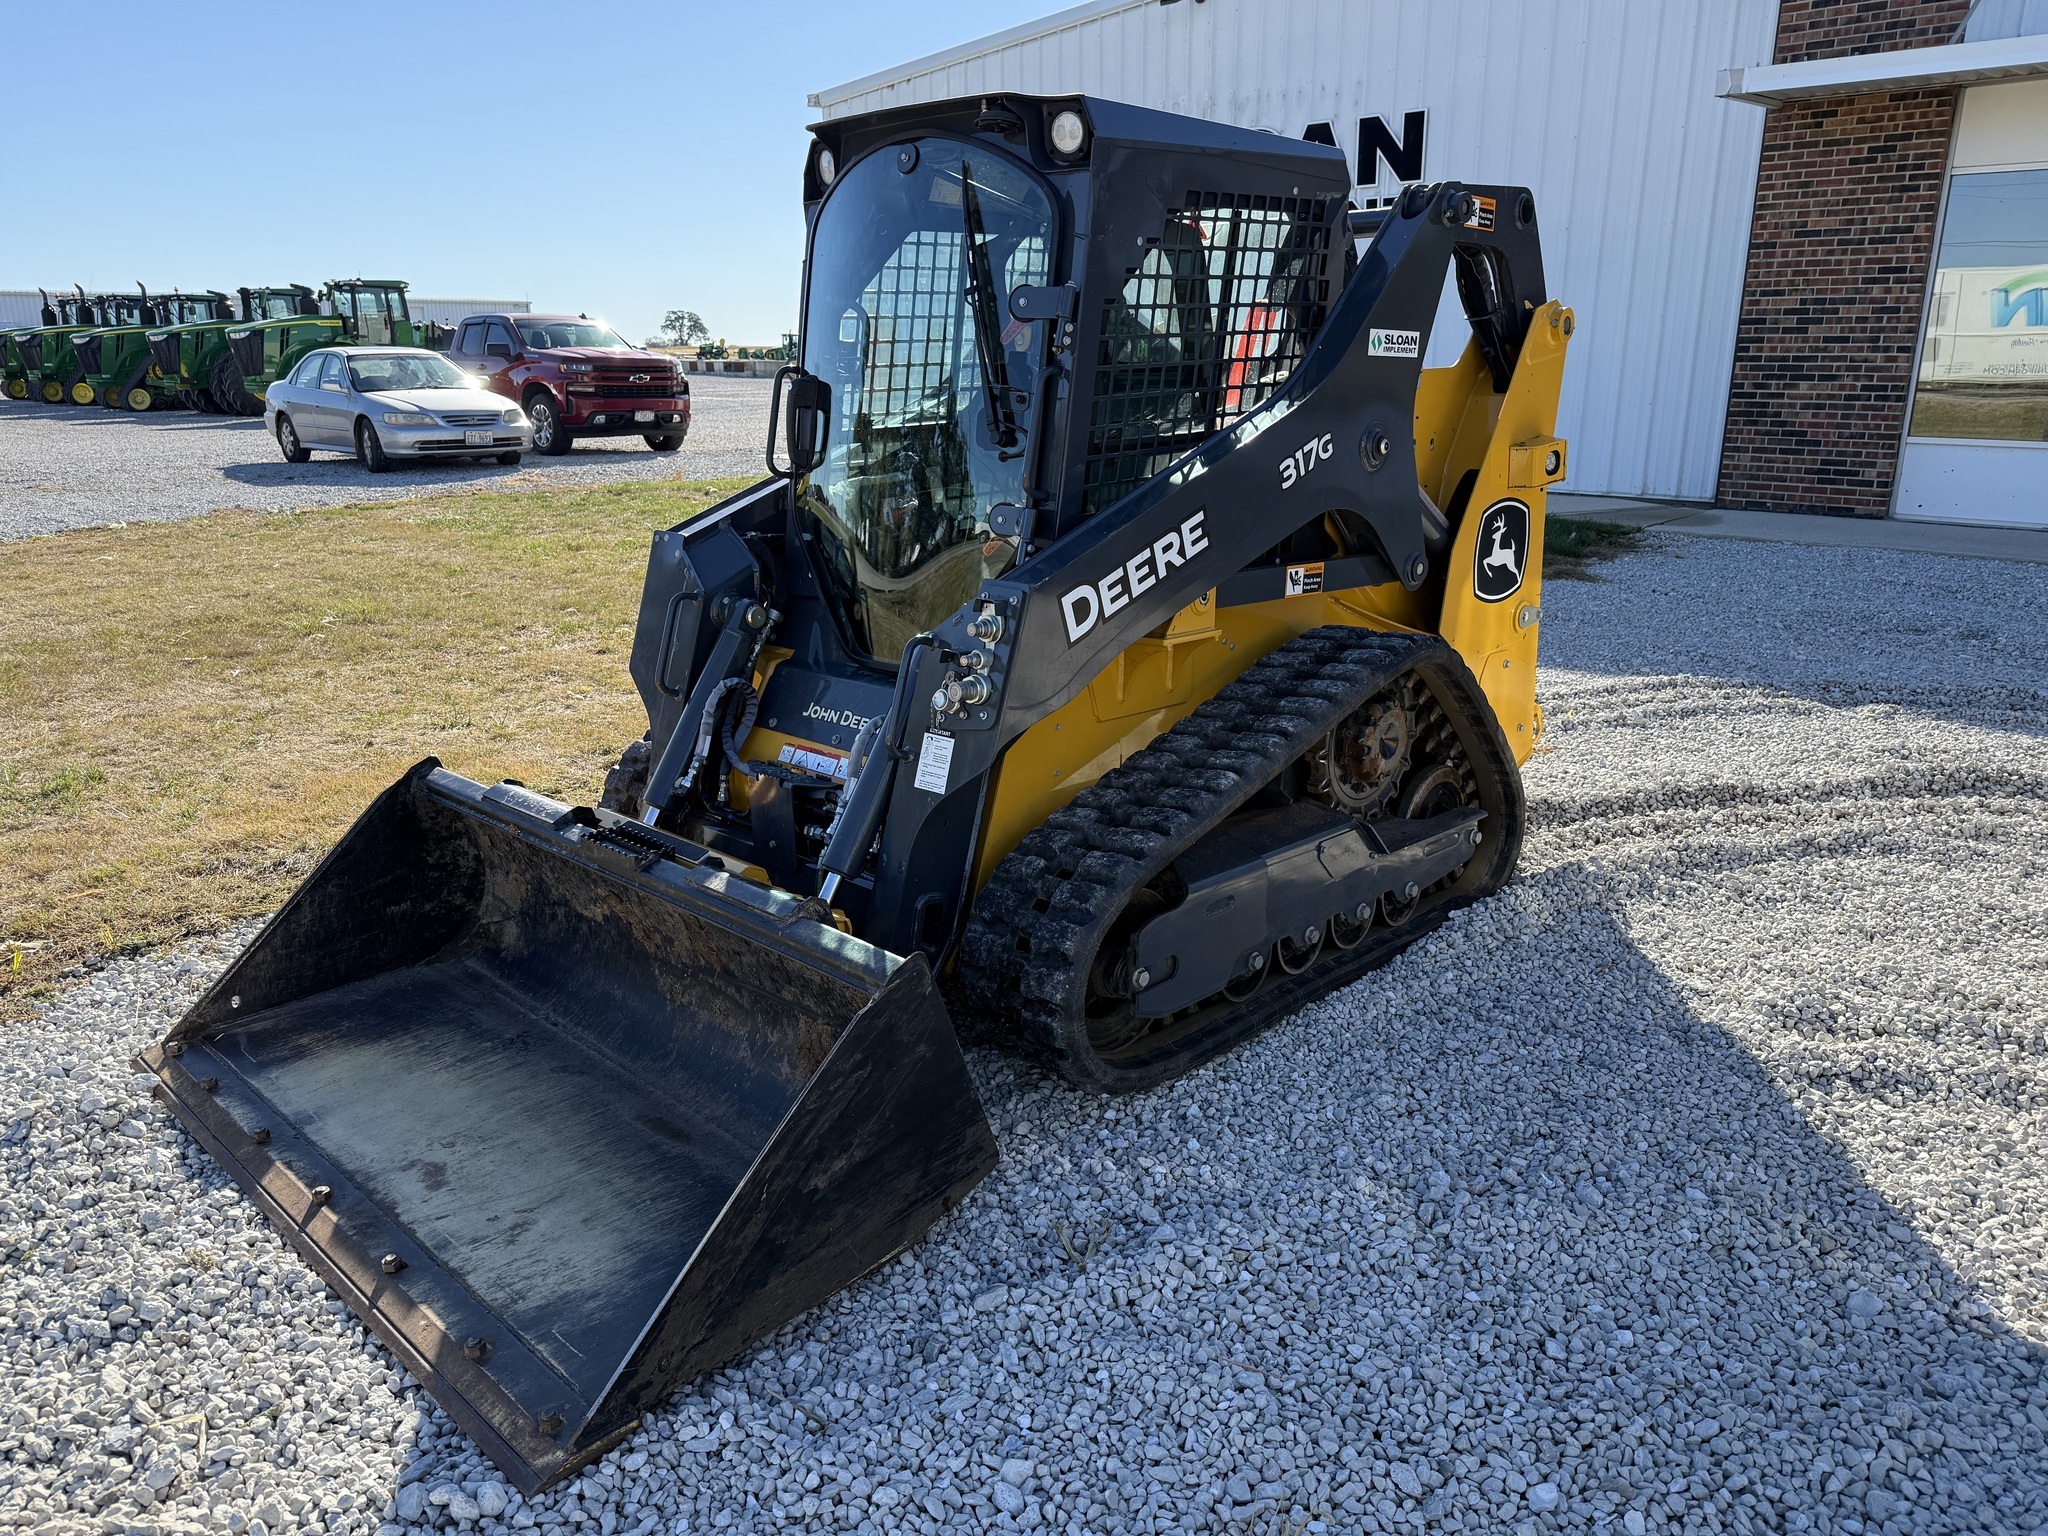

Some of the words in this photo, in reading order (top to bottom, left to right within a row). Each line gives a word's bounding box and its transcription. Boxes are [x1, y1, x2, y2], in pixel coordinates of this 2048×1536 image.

[1383, 346, 1417, 354] IMPLEMENT
[1384, 334, 1418, 346] SLOAN
[1279, 433, 1333, 489] 317G
[1061, 510, 1209, 643] DEERE
[802, 702, 840, 724] JOHN
